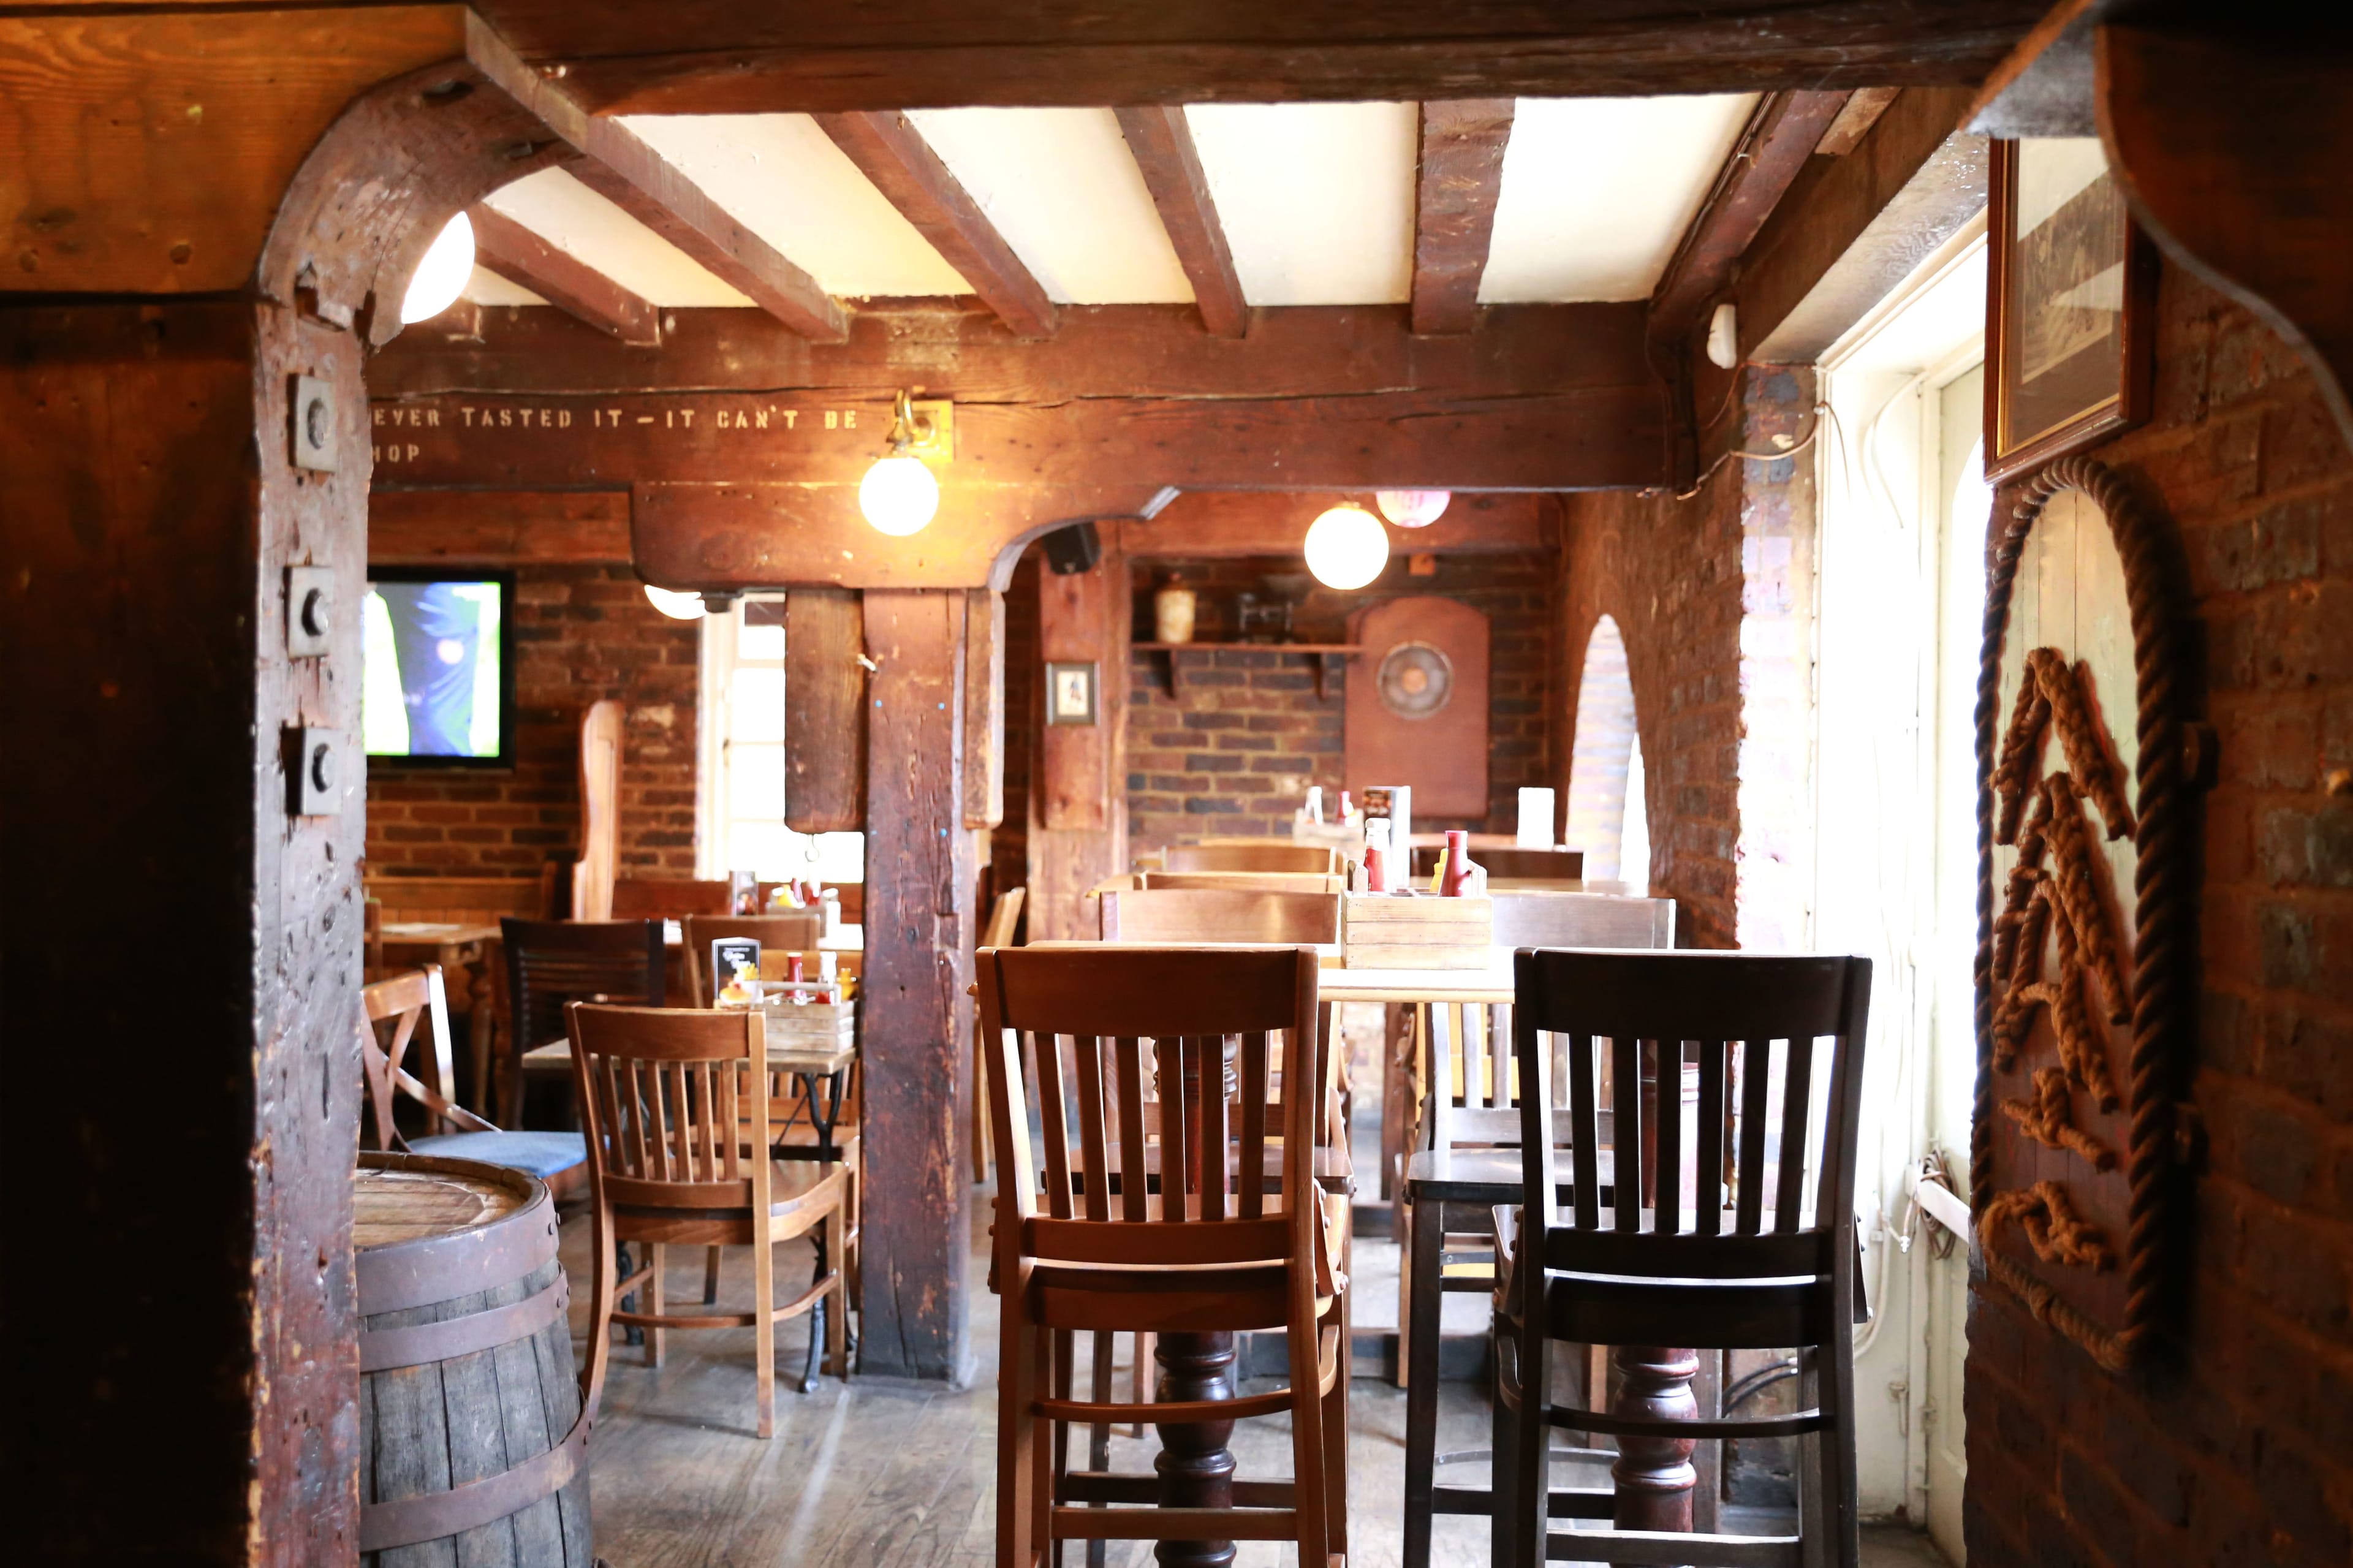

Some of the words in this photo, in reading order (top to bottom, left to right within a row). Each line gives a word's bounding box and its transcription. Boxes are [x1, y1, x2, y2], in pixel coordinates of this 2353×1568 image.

[462, 407, 571, 428] TASTED
[594, 409, 622, 428] IT
[667, 410, 694, 428] IT
[718, 404, 798, 429] CAN'T
[825, 410, 857, 430] BE
